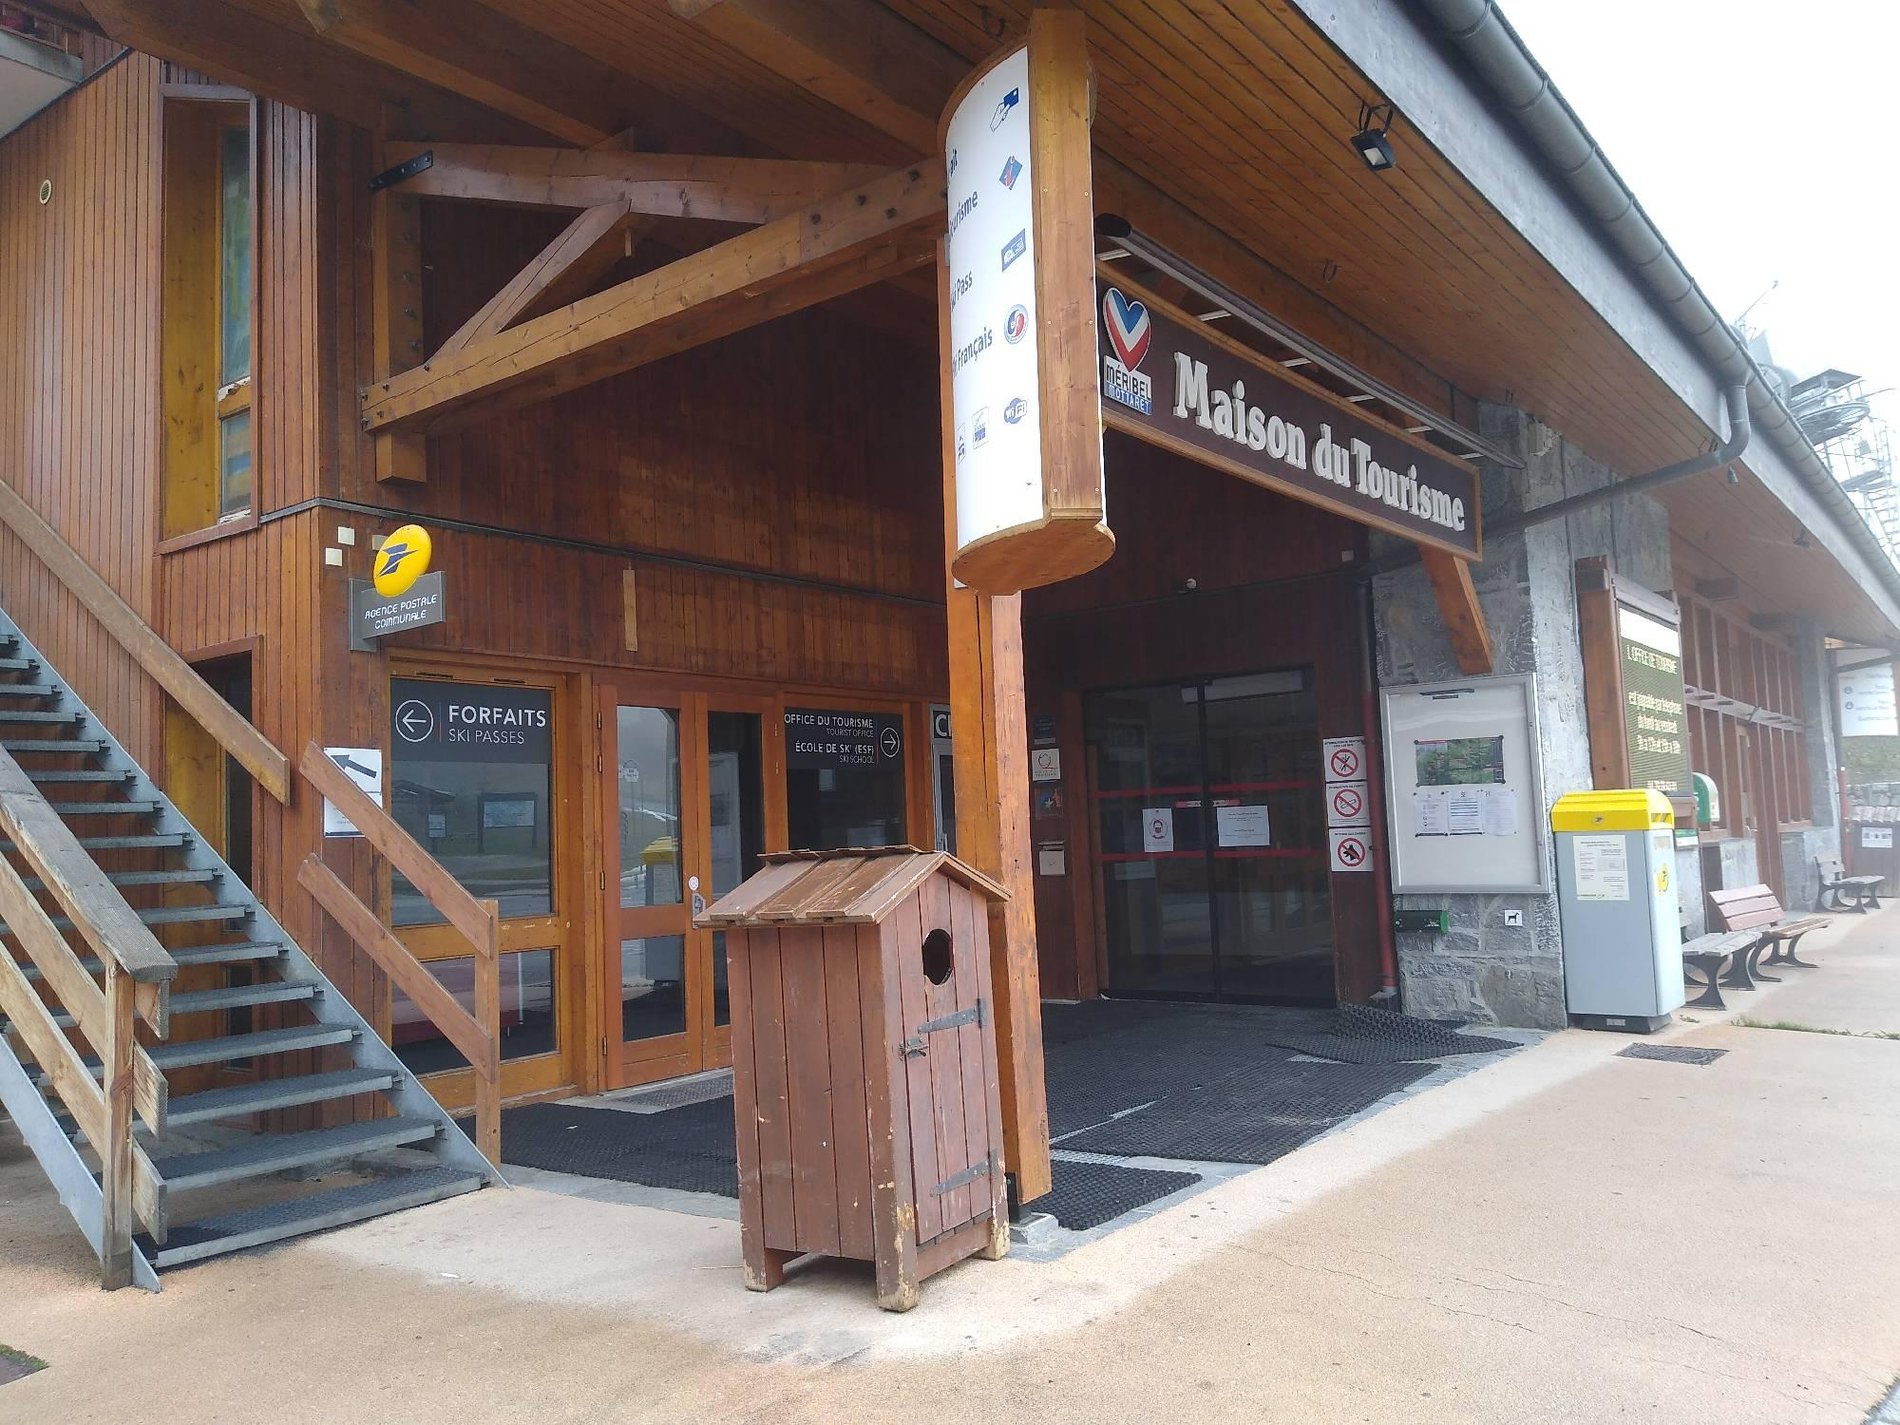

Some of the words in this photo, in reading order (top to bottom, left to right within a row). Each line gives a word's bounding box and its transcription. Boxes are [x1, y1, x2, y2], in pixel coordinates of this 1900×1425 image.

[957, 326, 993, 371] Français
[1173, 351, 1307, 470] Maison
[1312, 422, 1351, 488] du
[1351, 437, 1465, 532] Tourisme
[364, 603, 398, 620] AGENCE
[400, 593, 438, 612] POSTALE
[374, 610, 428, 630] COMMUNALE
[448, 705, 547, 728] FORFAITS
[784, 713, 815, 726] OFFICE
[817, 715, 830, 726] DU
[832, 716, 874, 729] TOURISME
[448, 728, 470, 743] SKI
[475, 729, 525, 745] PASSES
[826, 727, 852, 738] TOURIST
[852, 728, 874, 738] OFFICE
[795, 740, 824, 753] ÉCOLE
[826, 742, 837, 753] DE
